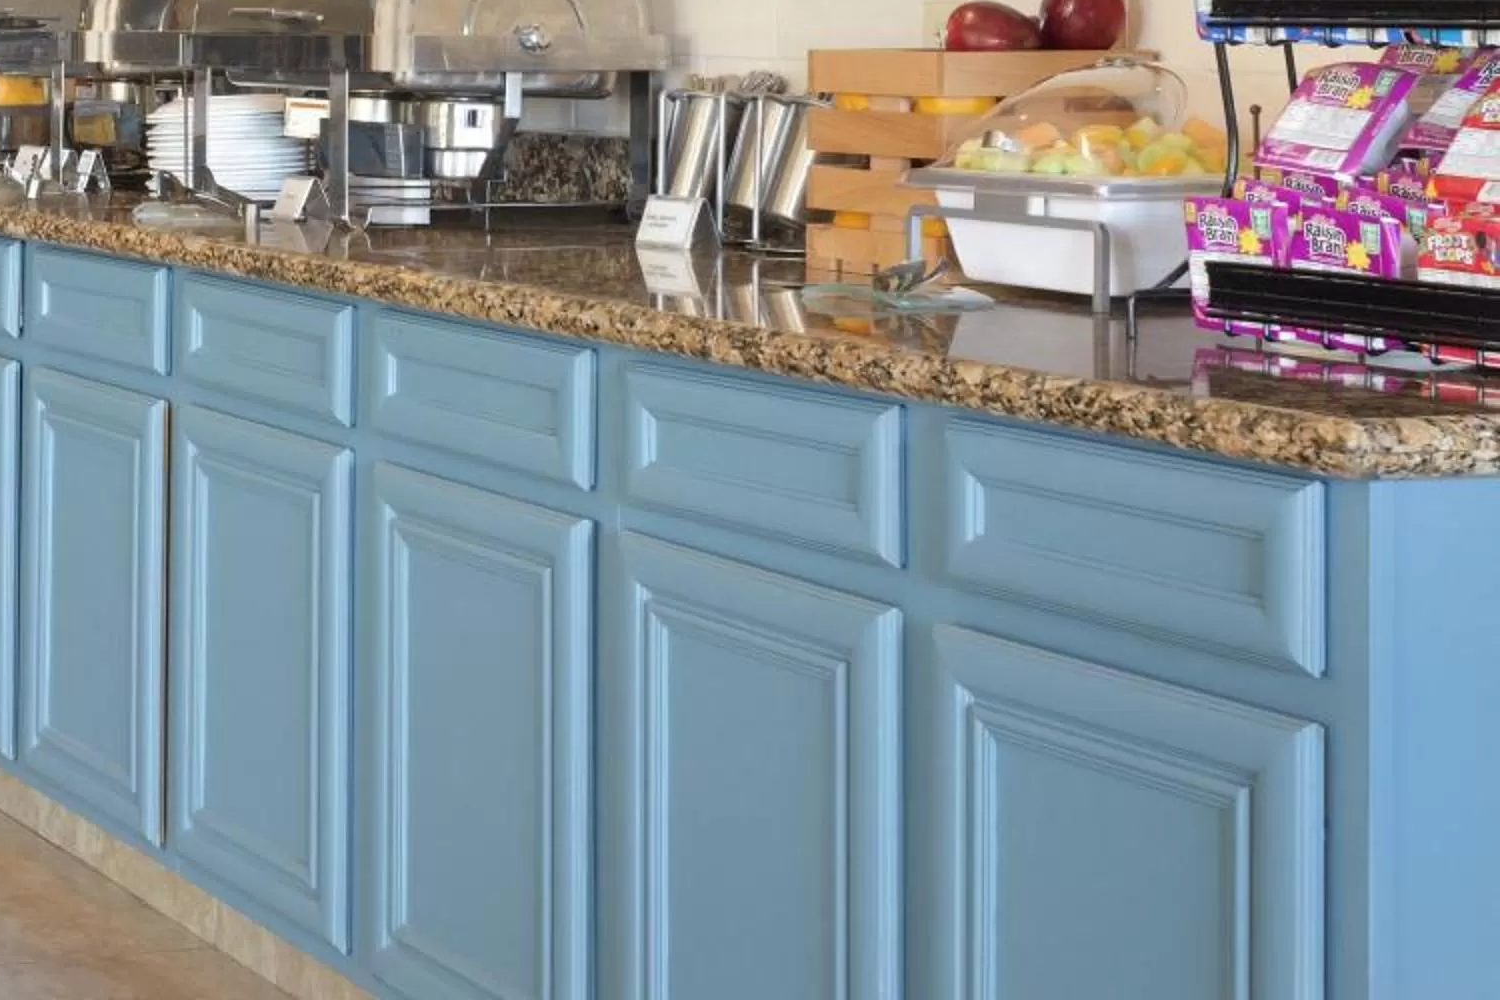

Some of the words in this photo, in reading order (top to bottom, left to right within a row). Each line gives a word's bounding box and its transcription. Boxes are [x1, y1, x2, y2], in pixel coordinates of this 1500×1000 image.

[1320, 70, 1360, 88] Raisin
[1315, 83, 1349, 100] Bran
[1199, 213, 1238, 232] Raisin
[1204, 228, 1237, 244] Bran
[1304, 222, 1345, 243] Raisin
[1311, 238, 1344, 257] Bran
